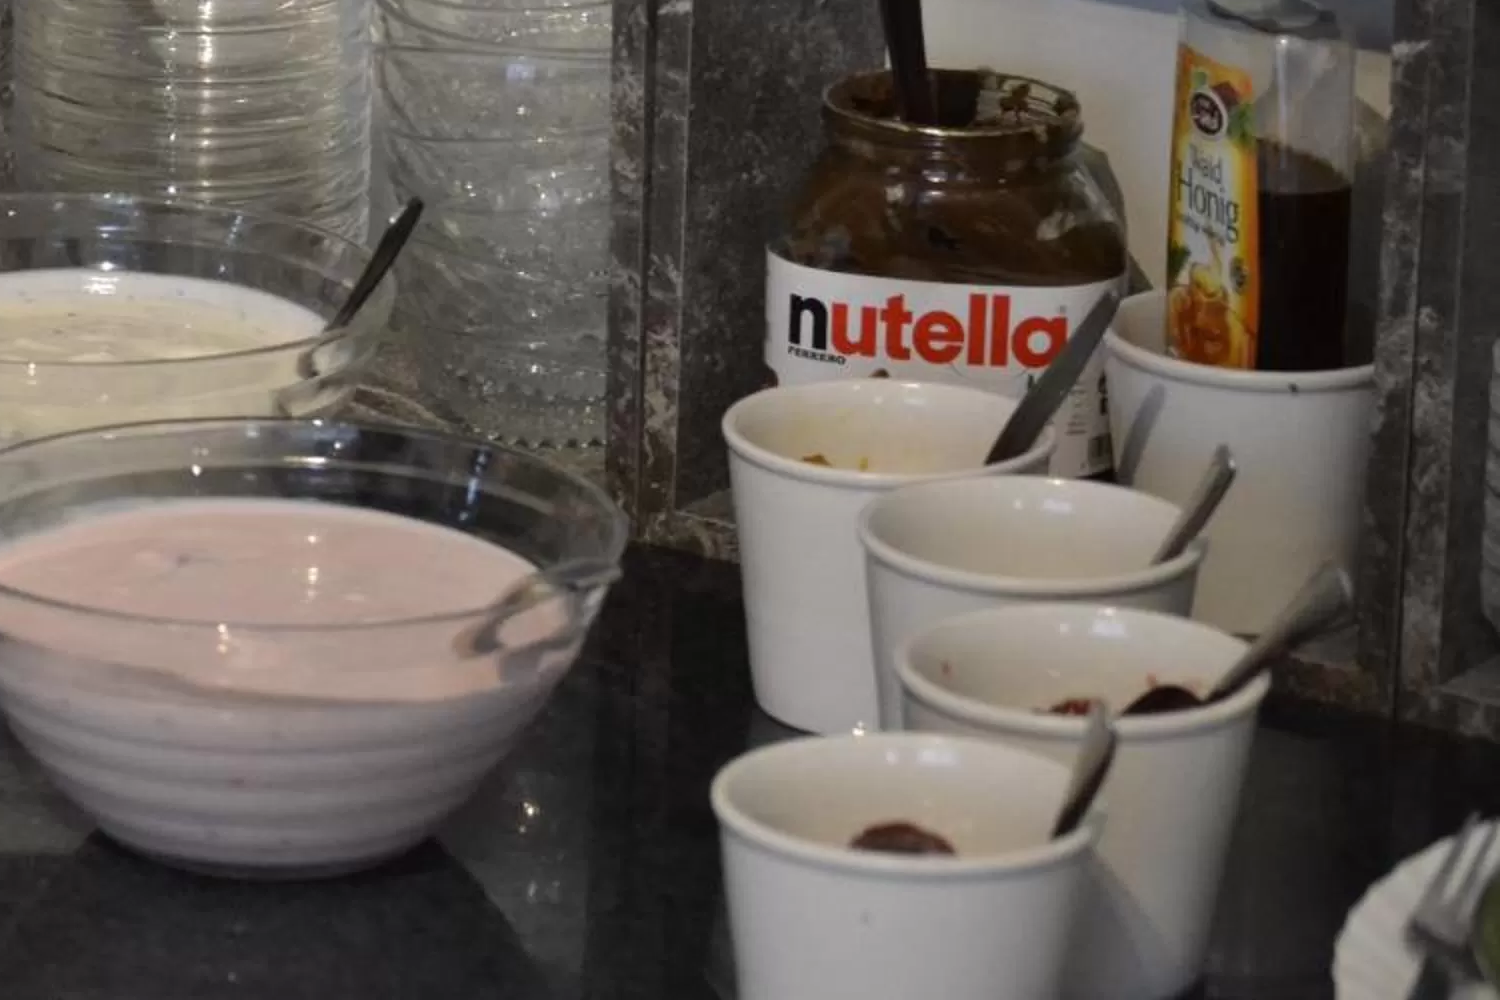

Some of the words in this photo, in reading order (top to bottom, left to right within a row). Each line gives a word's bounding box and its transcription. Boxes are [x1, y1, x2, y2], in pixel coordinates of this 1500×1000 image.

[1177, 159, 1239, 244] Honig
[787, 345, 846, 365] FERRERO
[788, 293, 1069, 369] nutella
